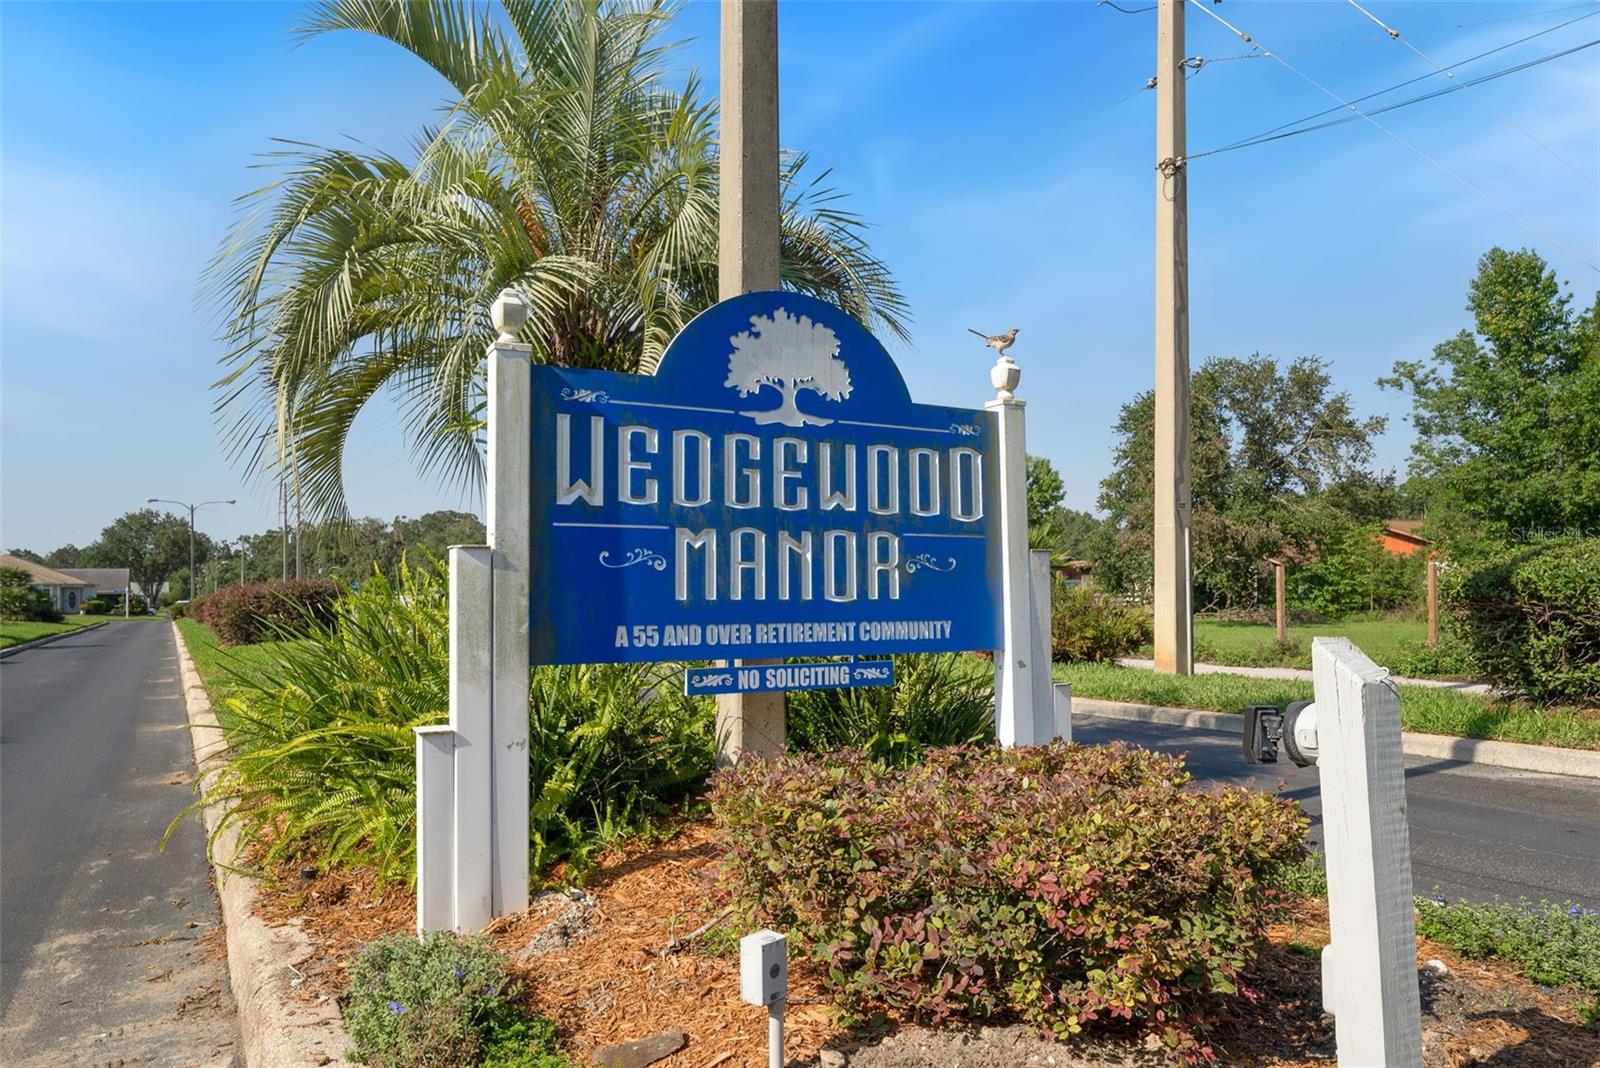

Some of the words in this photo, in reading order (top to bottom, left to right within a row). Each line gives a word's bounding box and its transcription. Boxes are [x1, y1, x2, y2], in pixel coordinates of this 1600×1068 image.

[556, 413, 984, 522] WEDGEWOOD
[675, 527, 901, 602] MANOR
[615, 625, 629, 648] A
[633, 625, 660, 647] 55
[663, 624, 702, 646] AND
[705, 624, 752, 646] OVER
[755, 621, 857, 644] RETIREMENT
[858, 620, 952, 642] COMMUNITY
[738, 669, 760, 690] NO
[765, 665, 850, 688] SOLICITING
